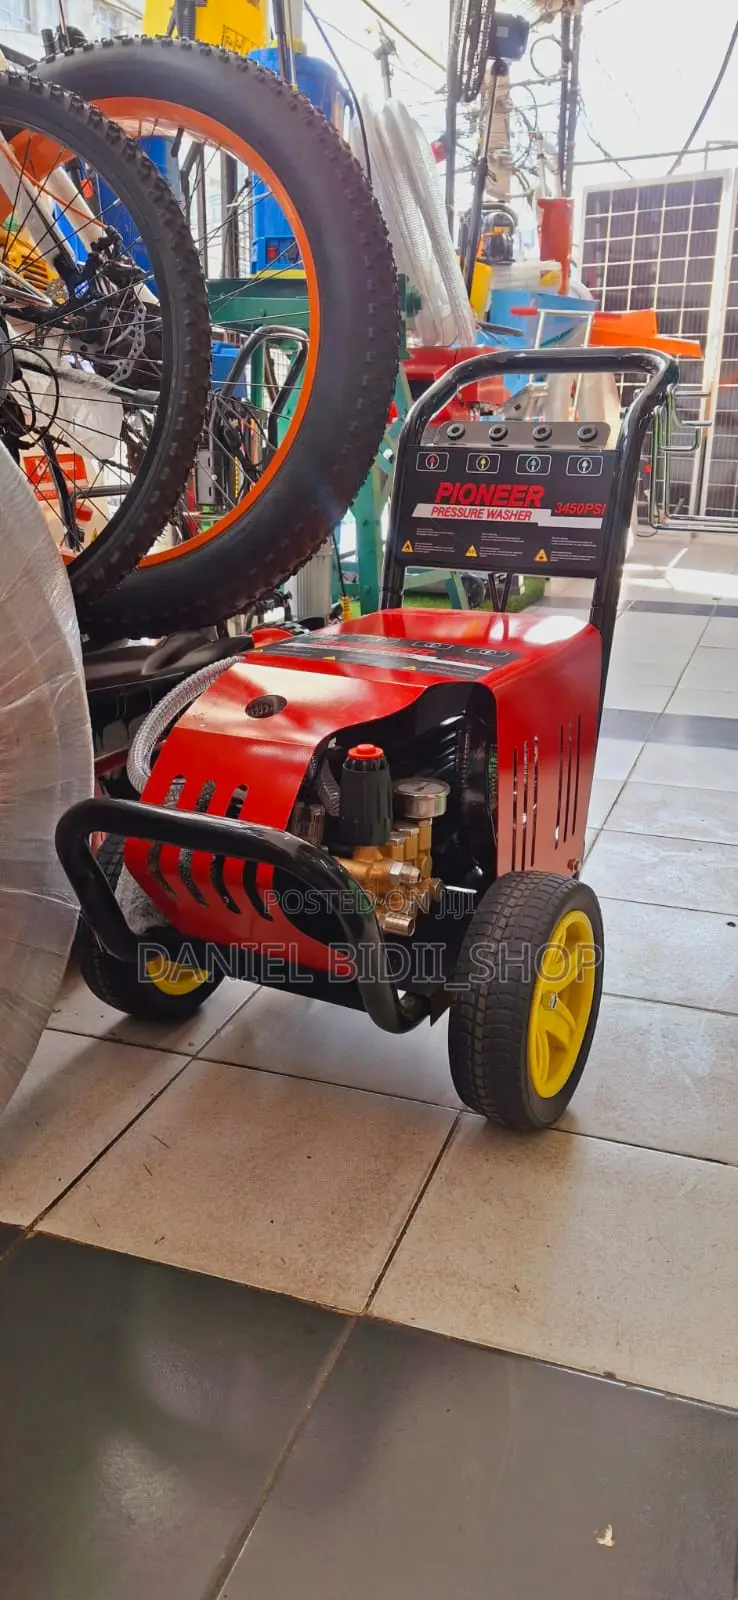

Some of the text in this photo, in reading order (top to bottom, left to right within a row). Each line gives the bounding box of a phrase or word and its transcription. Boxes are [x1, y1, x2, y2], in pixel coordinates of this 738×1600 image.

[434, 482, 544, 508] PIONEER
[431, 506, 532, 521] PRESSURE WASHER
[555, 502, 606, 516] 3450PSI
